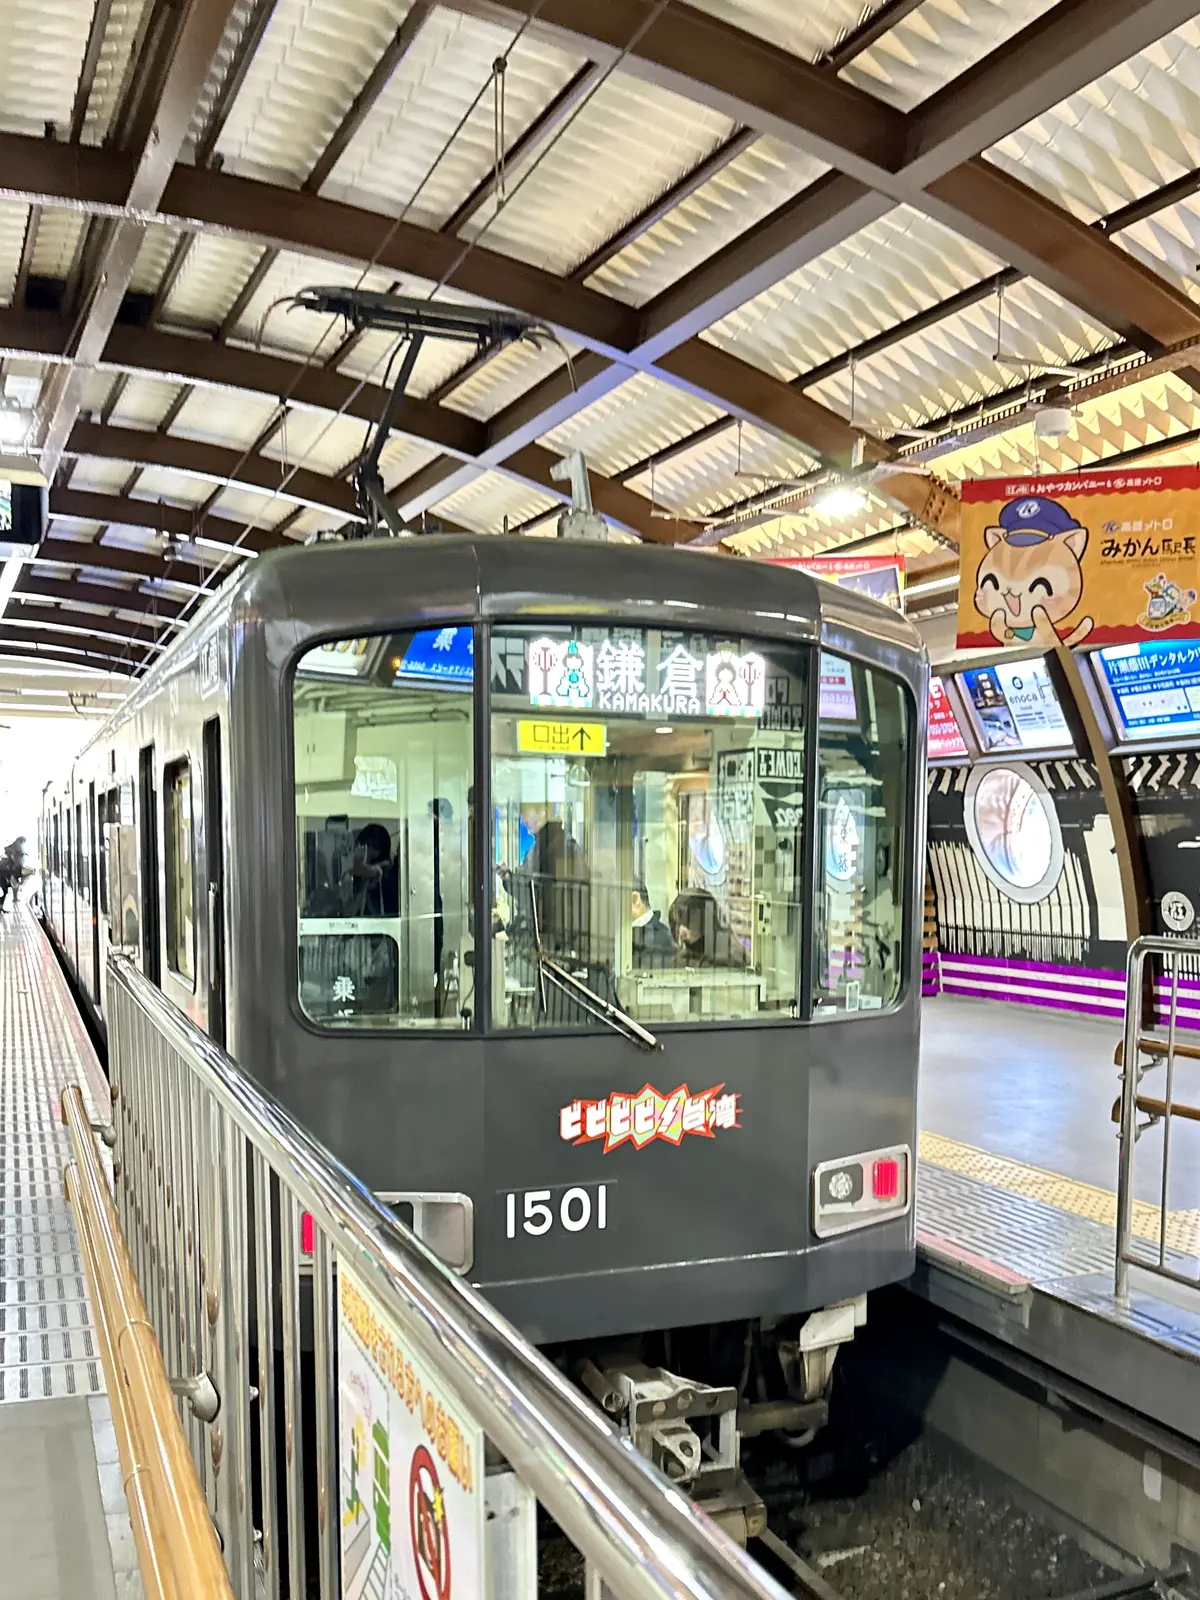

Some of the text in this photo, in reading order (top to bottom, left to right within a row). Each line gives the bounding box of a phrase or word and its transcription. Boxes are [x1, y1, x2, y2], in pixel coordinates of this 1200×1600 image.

[597, 640, 703, 697] 鎌倉
[599, 693, 701, 714] KAMAKURA
[506, 1184, 608, 1239] 1501
